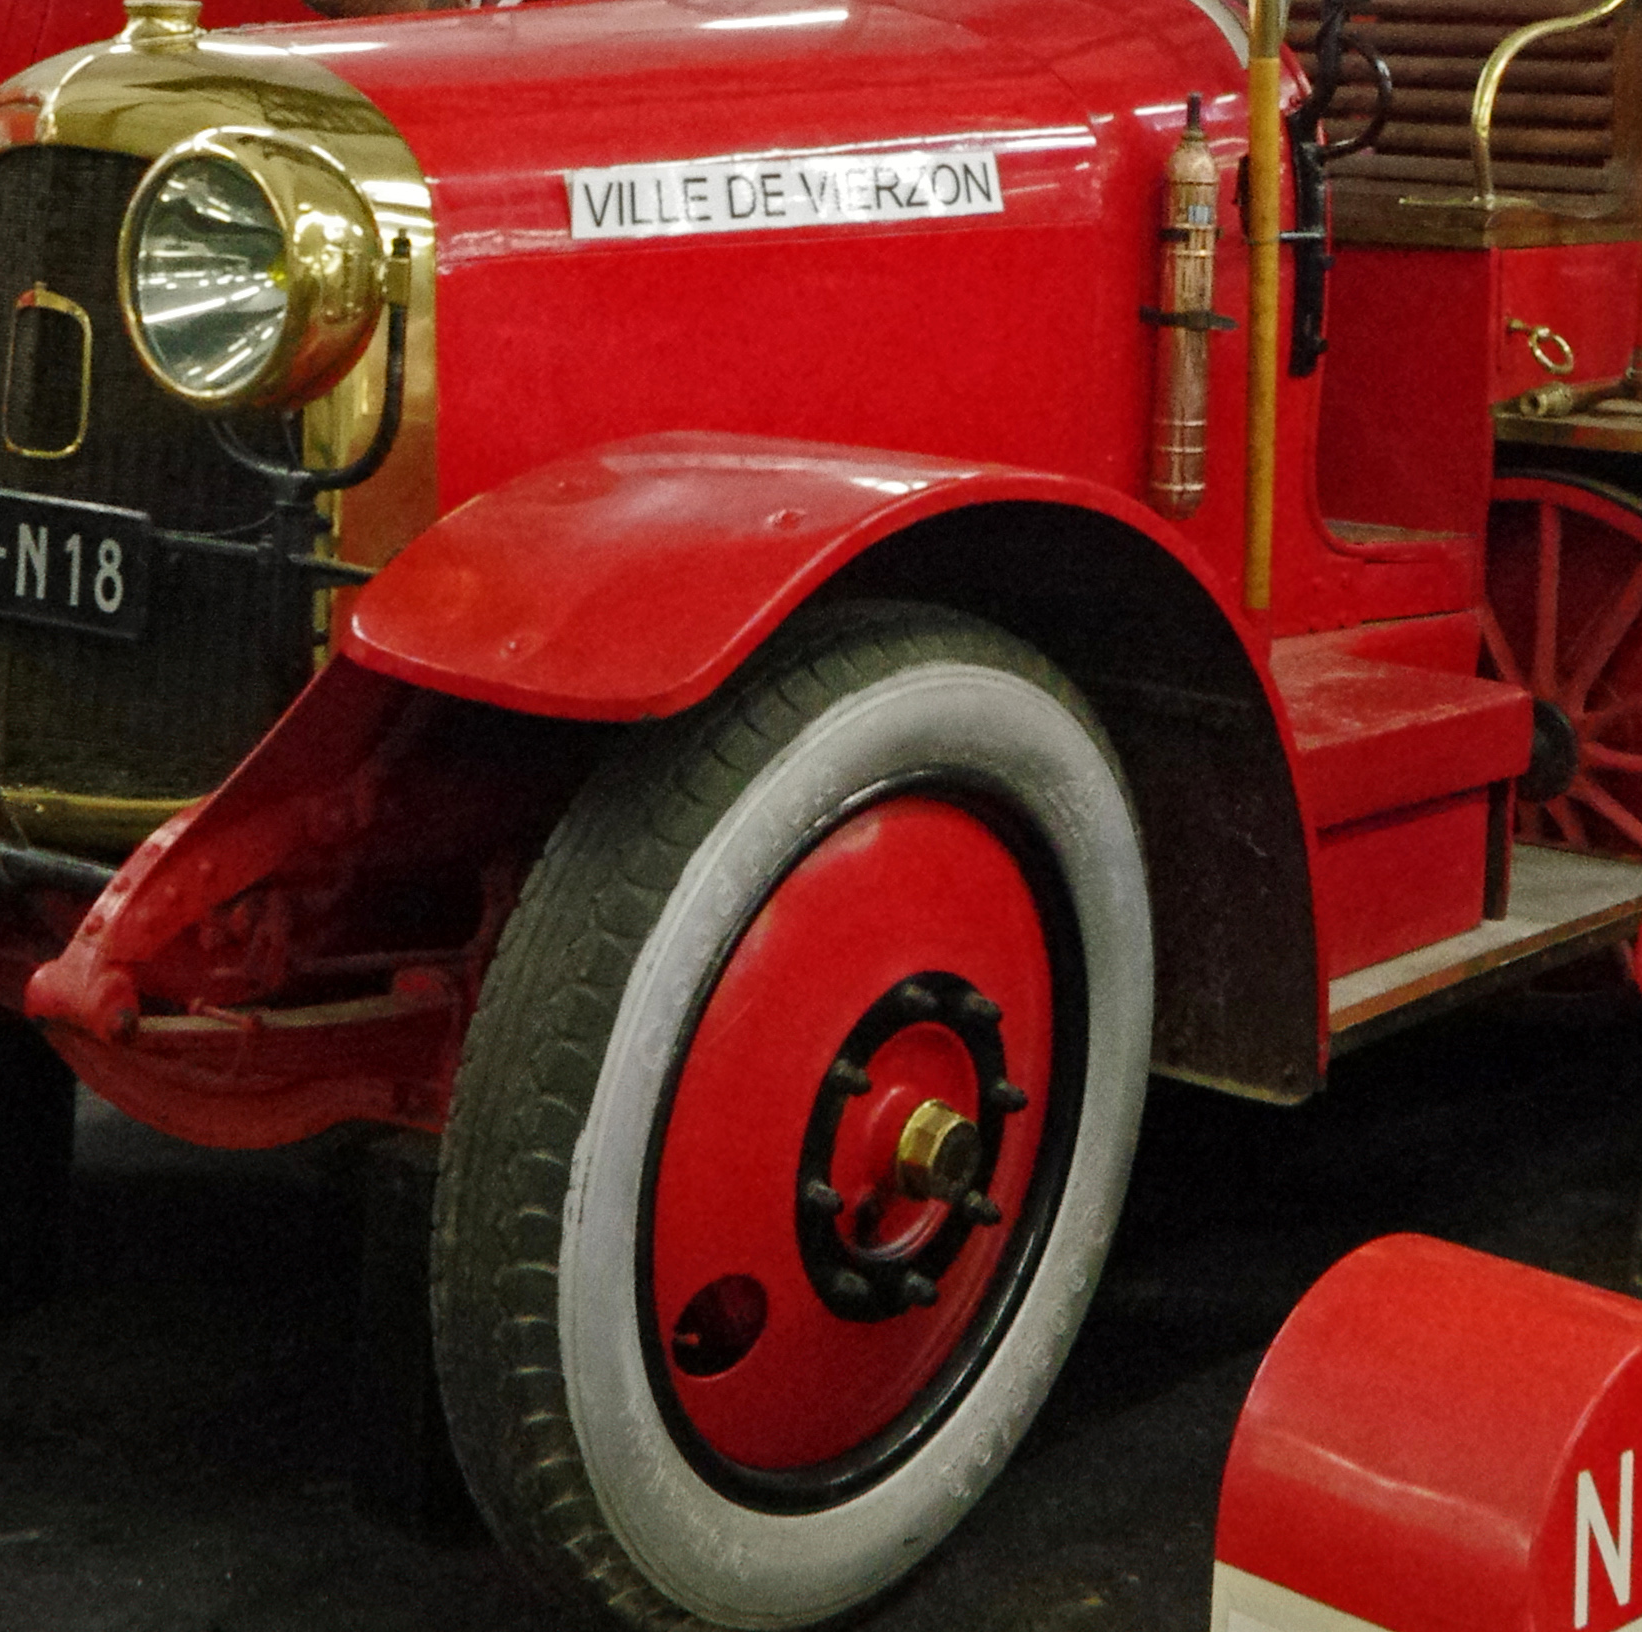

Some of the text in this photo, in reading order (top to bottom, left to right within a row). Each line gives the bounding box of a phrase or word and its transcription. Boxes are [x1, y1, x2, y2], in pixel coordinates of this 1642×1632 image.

[584, 160, 994, 229] VILLE DE VIERZON
[1573, 1449, 1635, 1630] N
